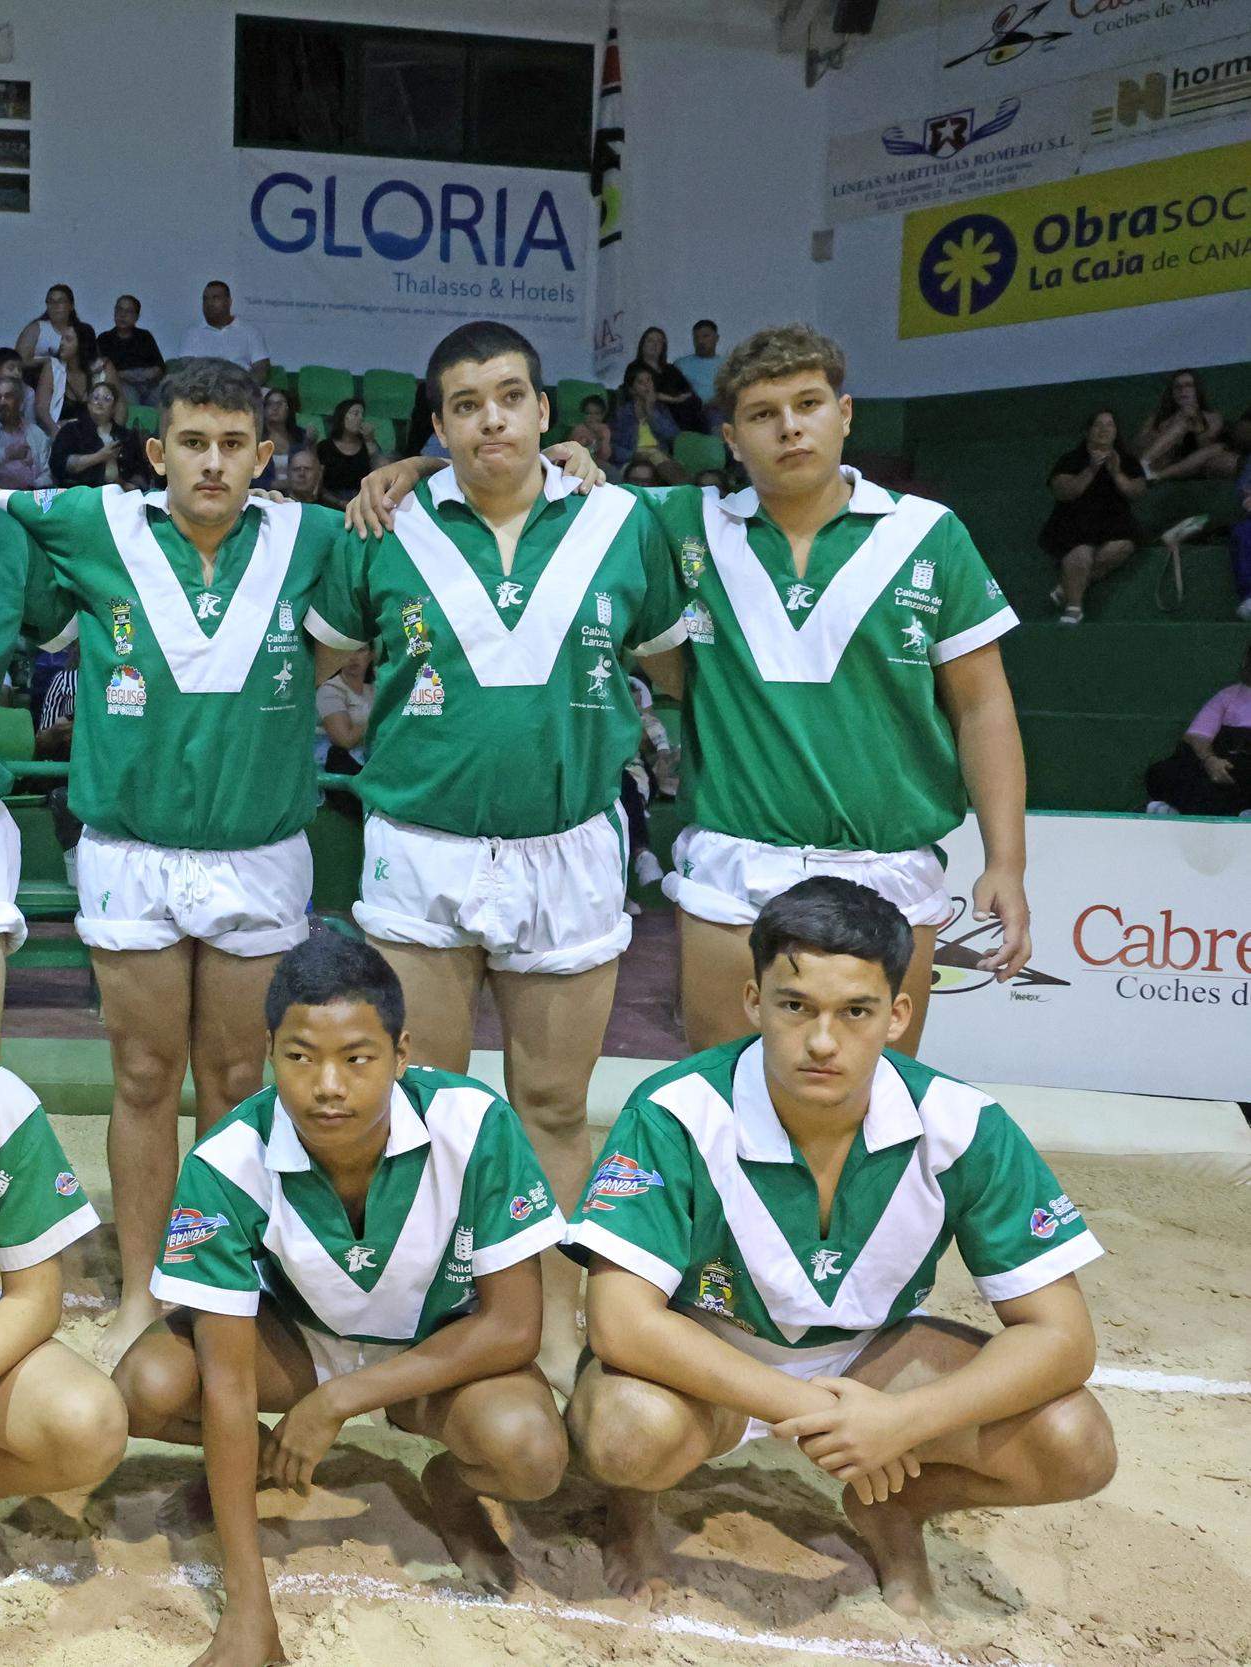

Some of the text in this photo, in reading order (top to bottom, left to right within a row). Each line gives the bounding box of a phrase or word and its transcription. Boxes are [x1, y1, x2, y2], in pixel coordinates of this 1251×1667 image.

[973, 141, 1043, 165] ROMERO
[251, 172, 575, 271] GLORIA
[1029, 266, 1063, 291] La
[1072, 251, 1144, 284] Caja
[1152, 251, 1180, 271] de
[394, 272, 575, 303] Thalasso & Hotels
[894, 587, 943, 606] Cabildo de
[895, 597, 939, 615] Lanzarote
[1116, 976, 1221, 1005] Coches
